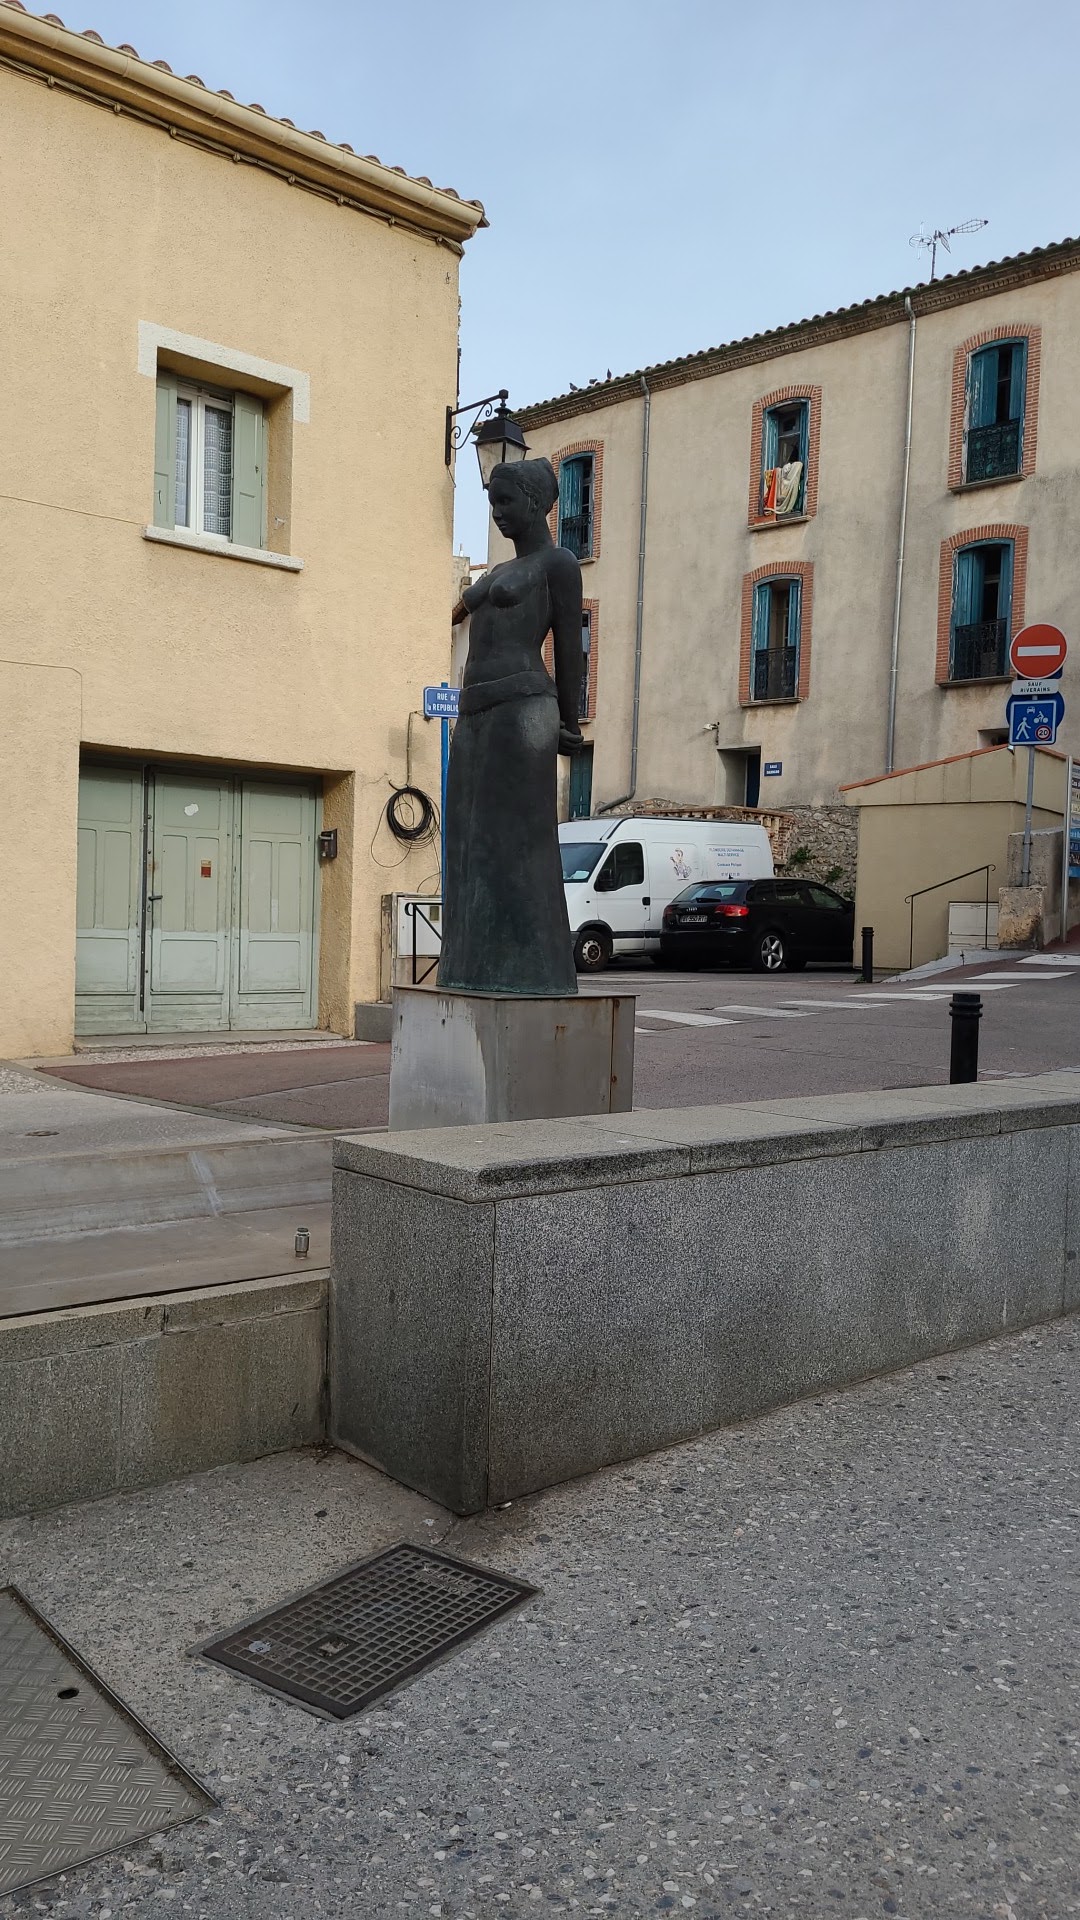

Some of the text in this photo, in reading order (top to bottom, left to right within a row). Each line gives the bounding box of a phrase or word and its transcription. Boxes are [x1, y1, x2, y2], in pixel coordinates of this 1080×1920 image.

[436, 692, 456, 701] RUE de
[426, 1569, 472, 1588] SERVICE
